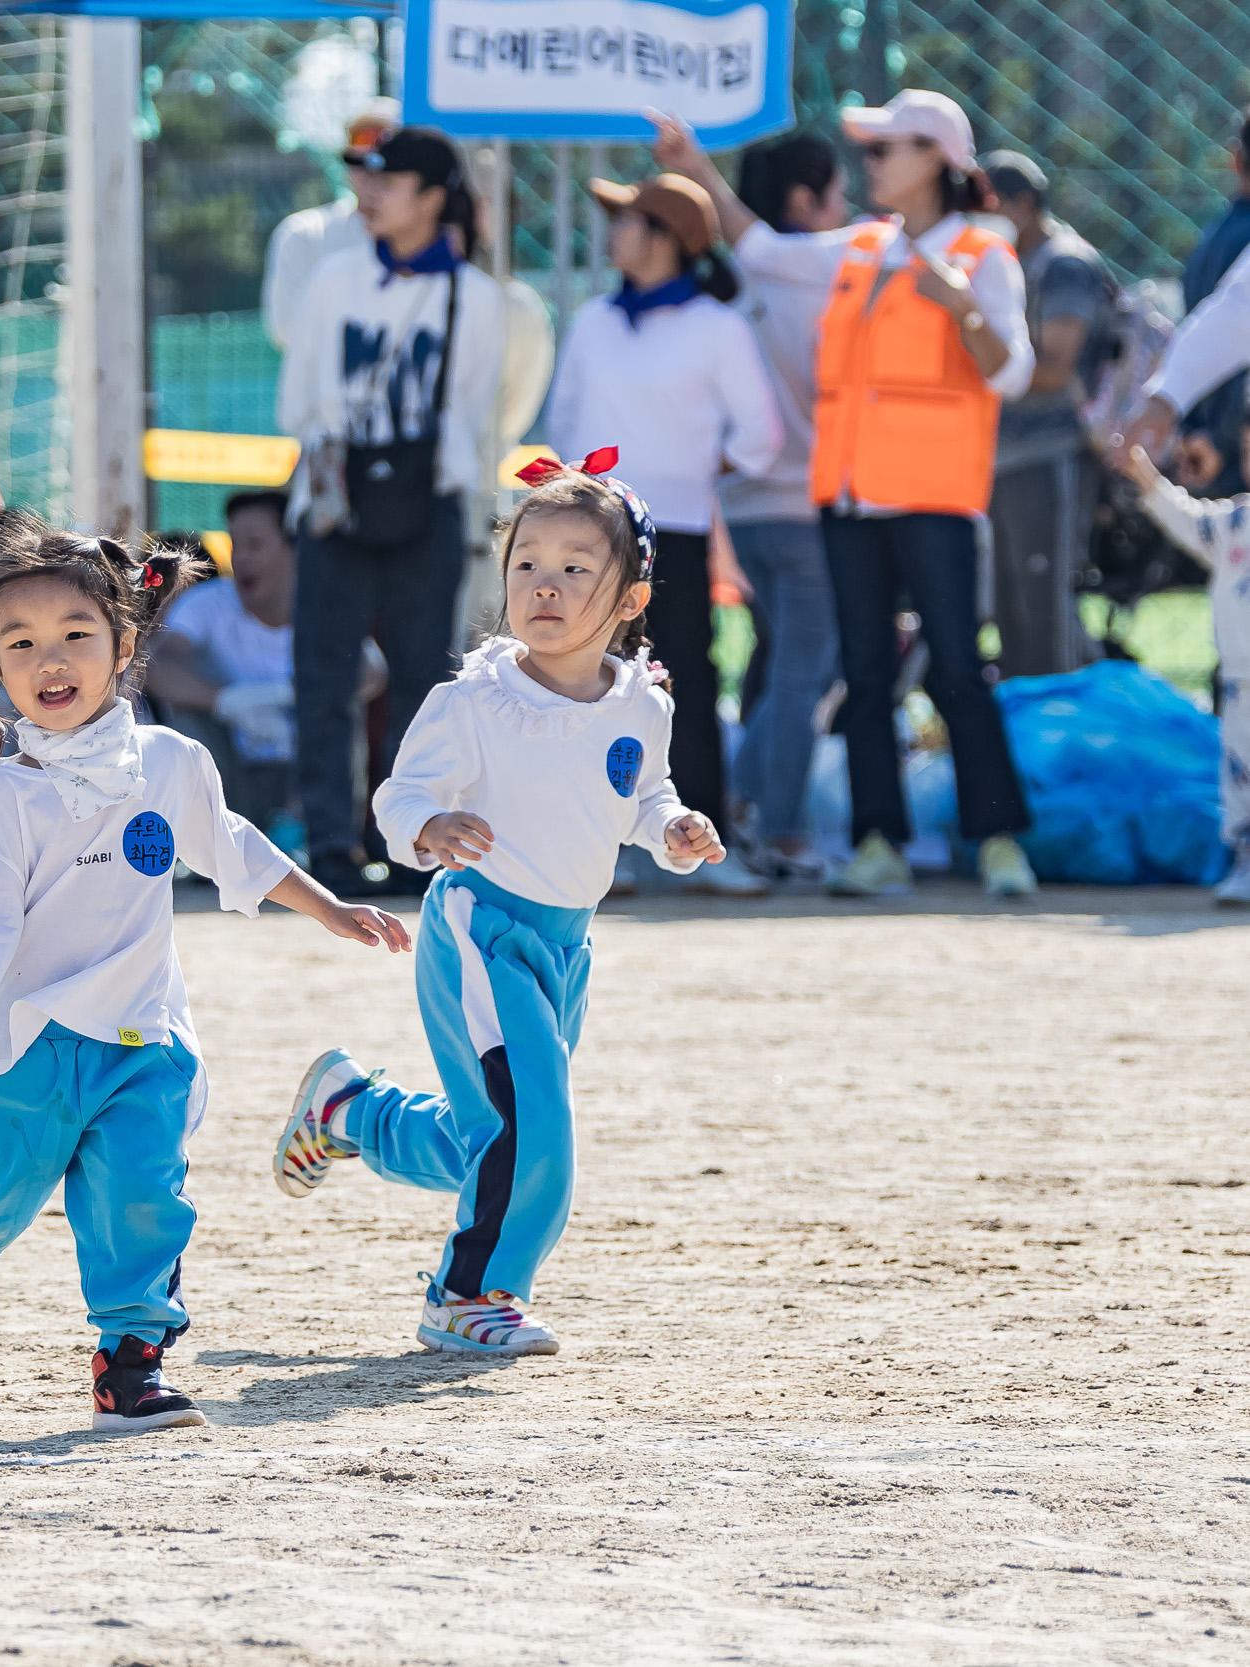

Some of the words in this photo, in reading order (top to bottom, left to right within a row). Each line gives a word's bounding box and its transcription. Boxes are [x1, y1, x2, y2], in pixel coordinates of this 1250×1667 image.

[128, 818, 169, 842] 푸르내
[76, 852, 111, 866] SUABI
[129, 843, 170, 869] 최수경
